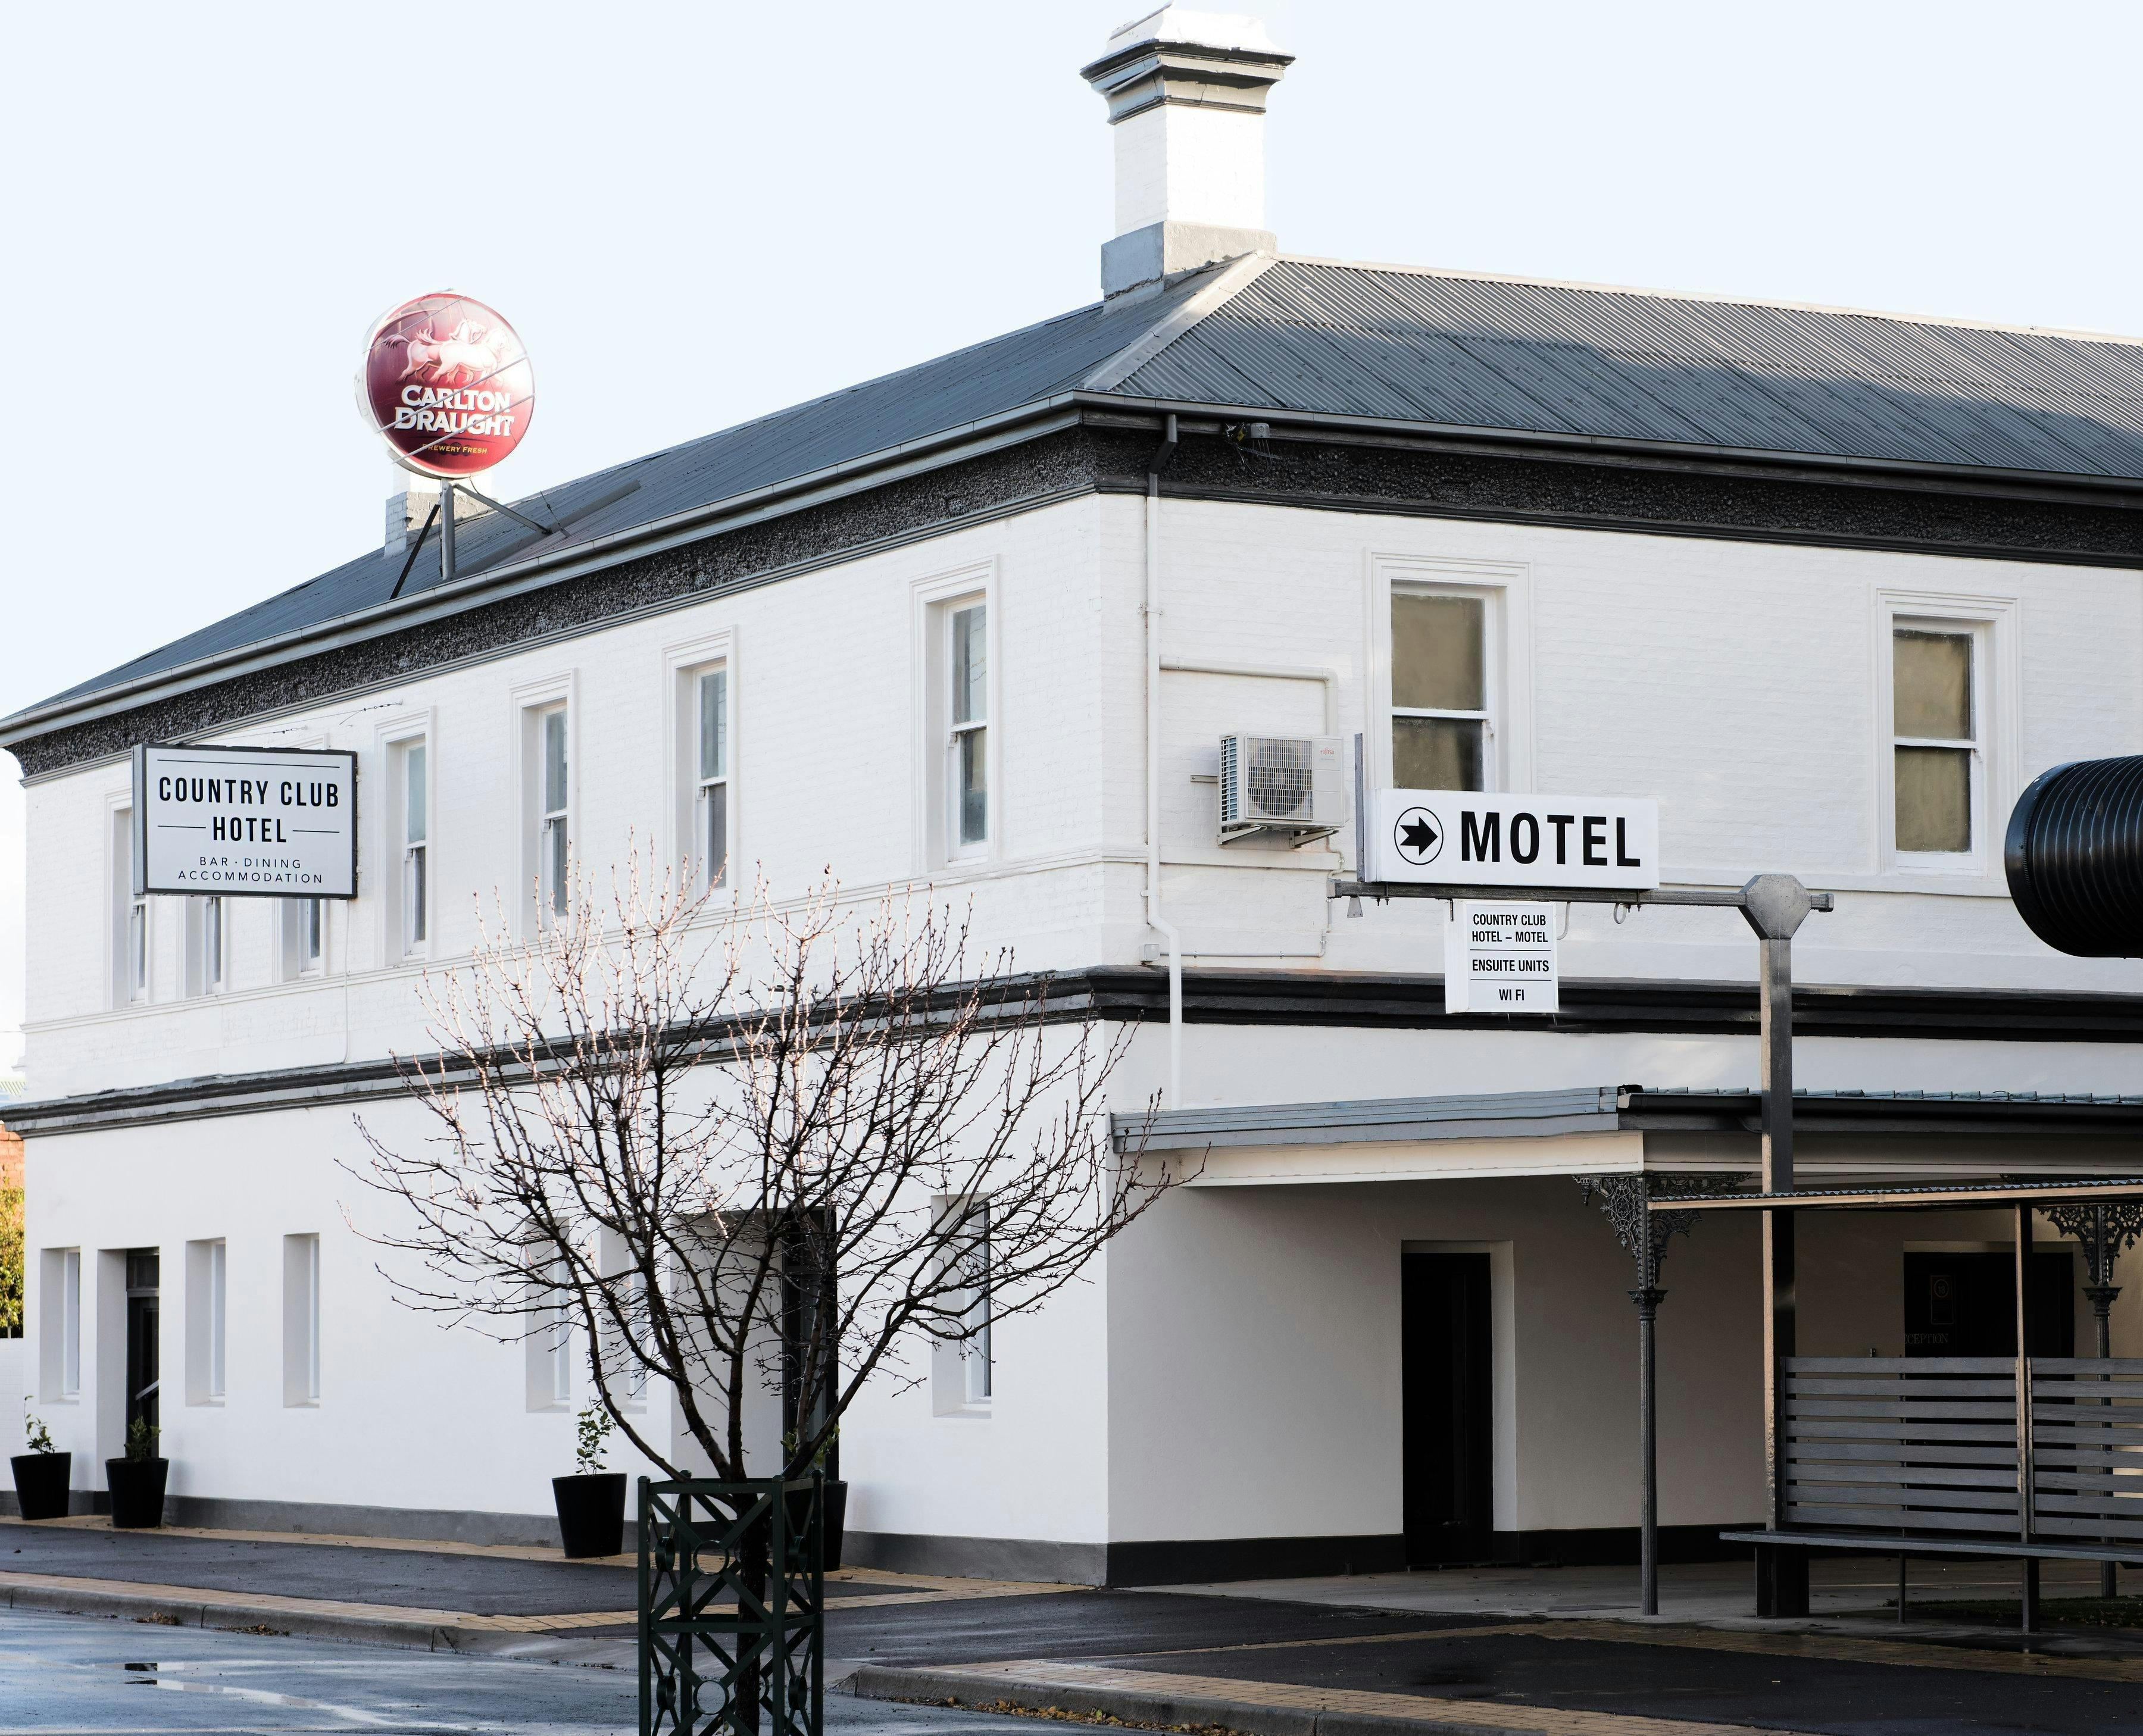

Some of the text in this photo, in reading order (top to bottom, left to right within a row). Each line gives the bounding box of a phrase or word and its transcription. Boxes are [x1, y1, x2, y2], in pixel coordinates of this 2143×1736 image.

[401, 385, 510, 413] CARLTON
[394, 407, 514, 436] DRAUGHT
[159, 777, 339, 807] COUNTRY CLUB
[213, 817, 287, 843] HOTEL
[1461, 811, 1641, 867] MOTEL
[199, 856, 229, 867] BAR
[244, 858, 301, 869] DINING
[178, 871, 322, 884] ACCOMMODATION
[1473, 914, 1546, 925] COUNTRY CLUB
[1472, 931, 1502, 942] HOTEL
[1516, 931, 1548, 942] MOTEL
[1472, 959, 1550, 972] ENSUITE UNITS
[1499, 989, 1525, 1000] WI FI
